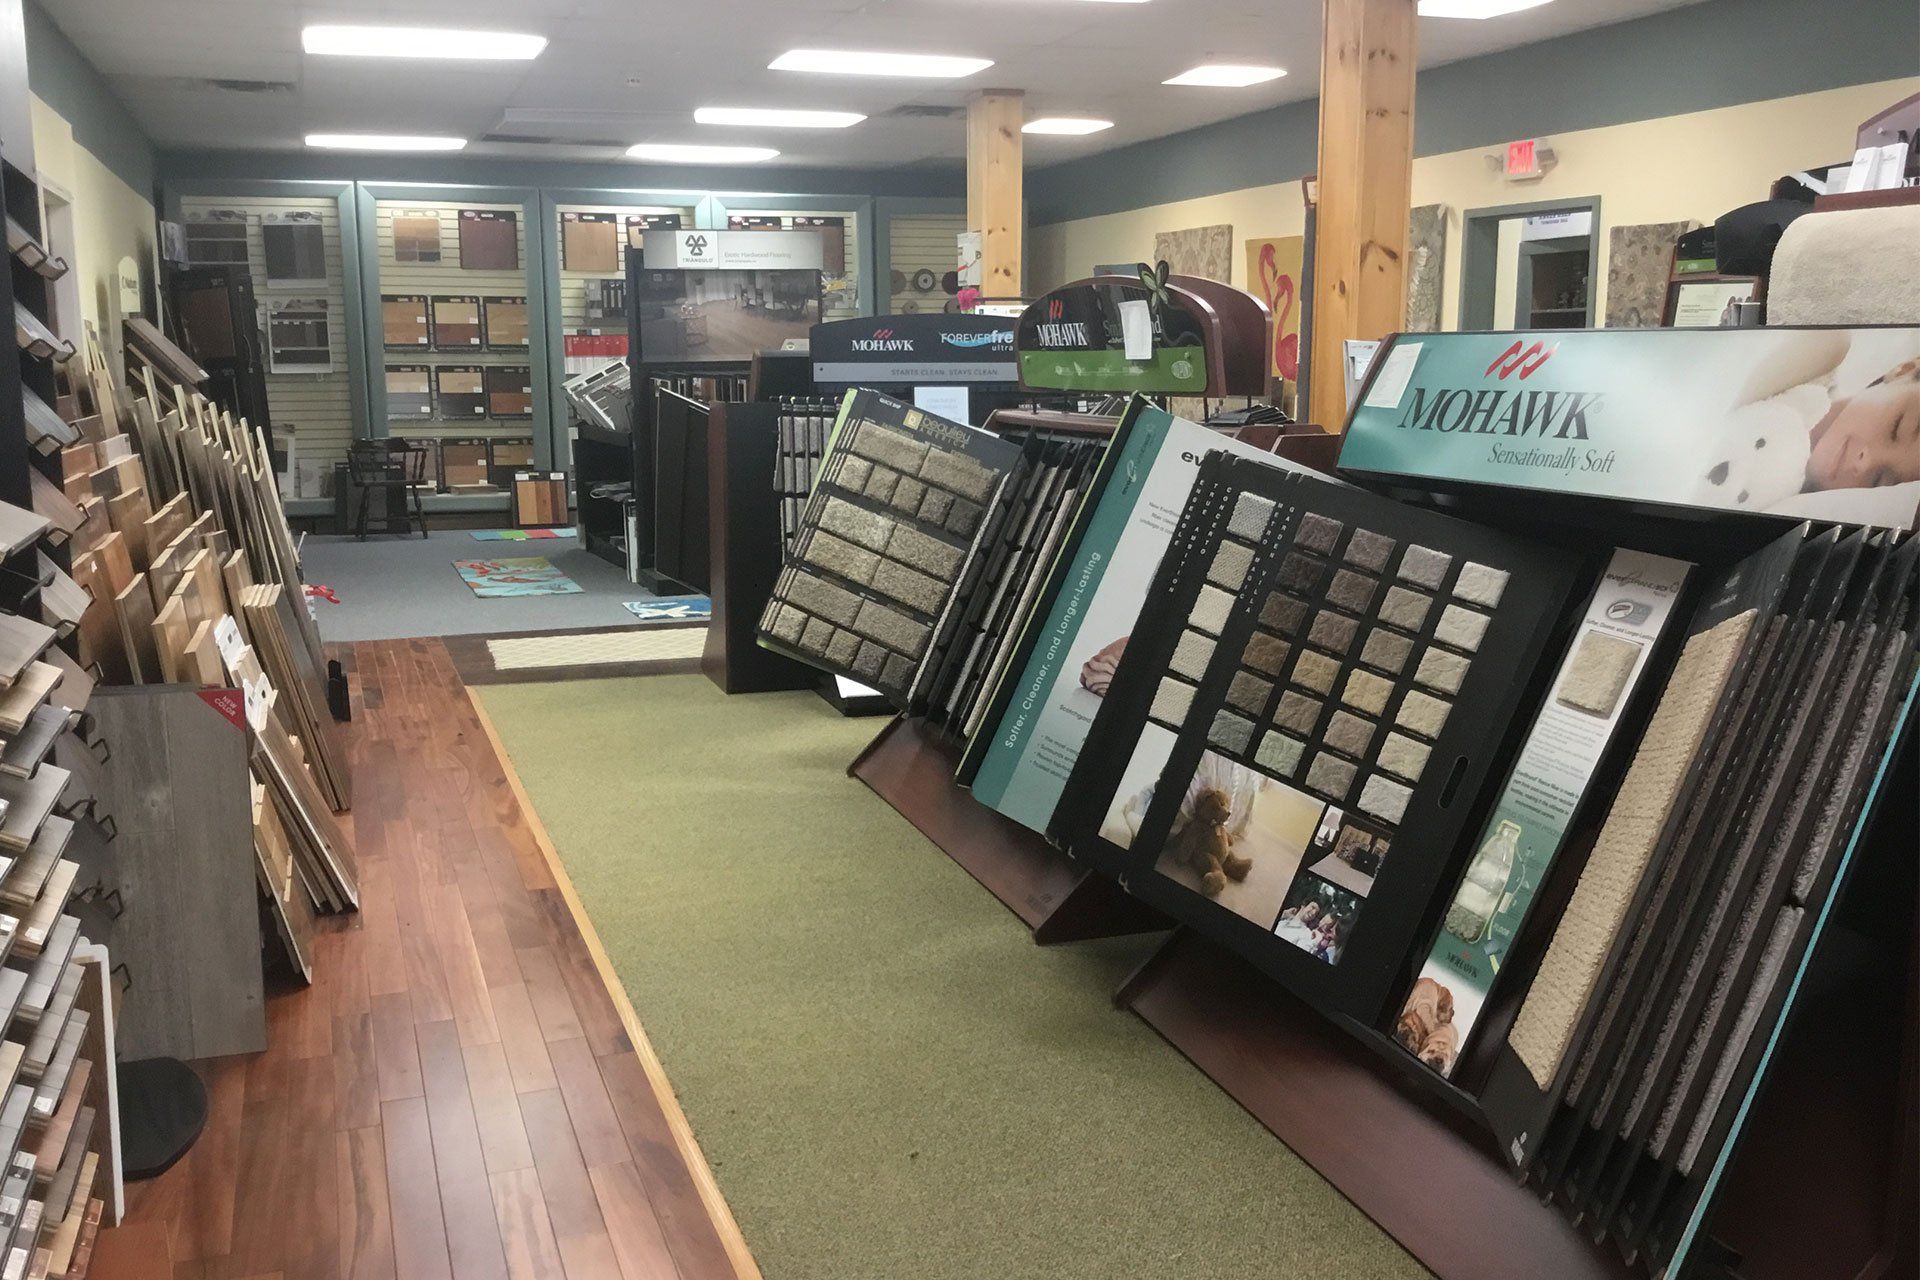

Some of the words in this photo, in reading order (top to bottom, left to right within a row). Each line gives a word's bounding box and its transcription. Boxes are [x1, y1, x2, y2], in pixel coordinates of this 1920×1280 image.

[1507, 140, 1534, 174] EXIT
[851, 340, 914, 351] MOHAWK
[1036, 322, 1088, 347] MOHAWK
[1397, 387, 1605, 440] MOHAWK
[1487, 443, 1580, 476] Sensationally
[1580, 449, 1615, 473] Soft
[1174, 479, 1205, 547] ENSEMBLE
[1200, 486, 1232, 555] CONCERTO
[1202, 483, 1219, 516] TRUE
[1262, 502, 1284, 546] METRO
[1269, 506, 1295, 559] GARDEN
[1168, 526, 1200, 593] AMBITION
[1239, 557, 1260, 599] MAGIC
[1245, 570, 1267, 613] VILLA
[1004, 712, 1027, 748] Softer,
[1022, 663, 1051, 712] Cleaner,
[1045, 638, 1062, 661] and
[1059, 551, 1102, 635] Longer-Lasting
[214, 697, 235, 717] COLOR
[221, 695, 237, 709] NEW
